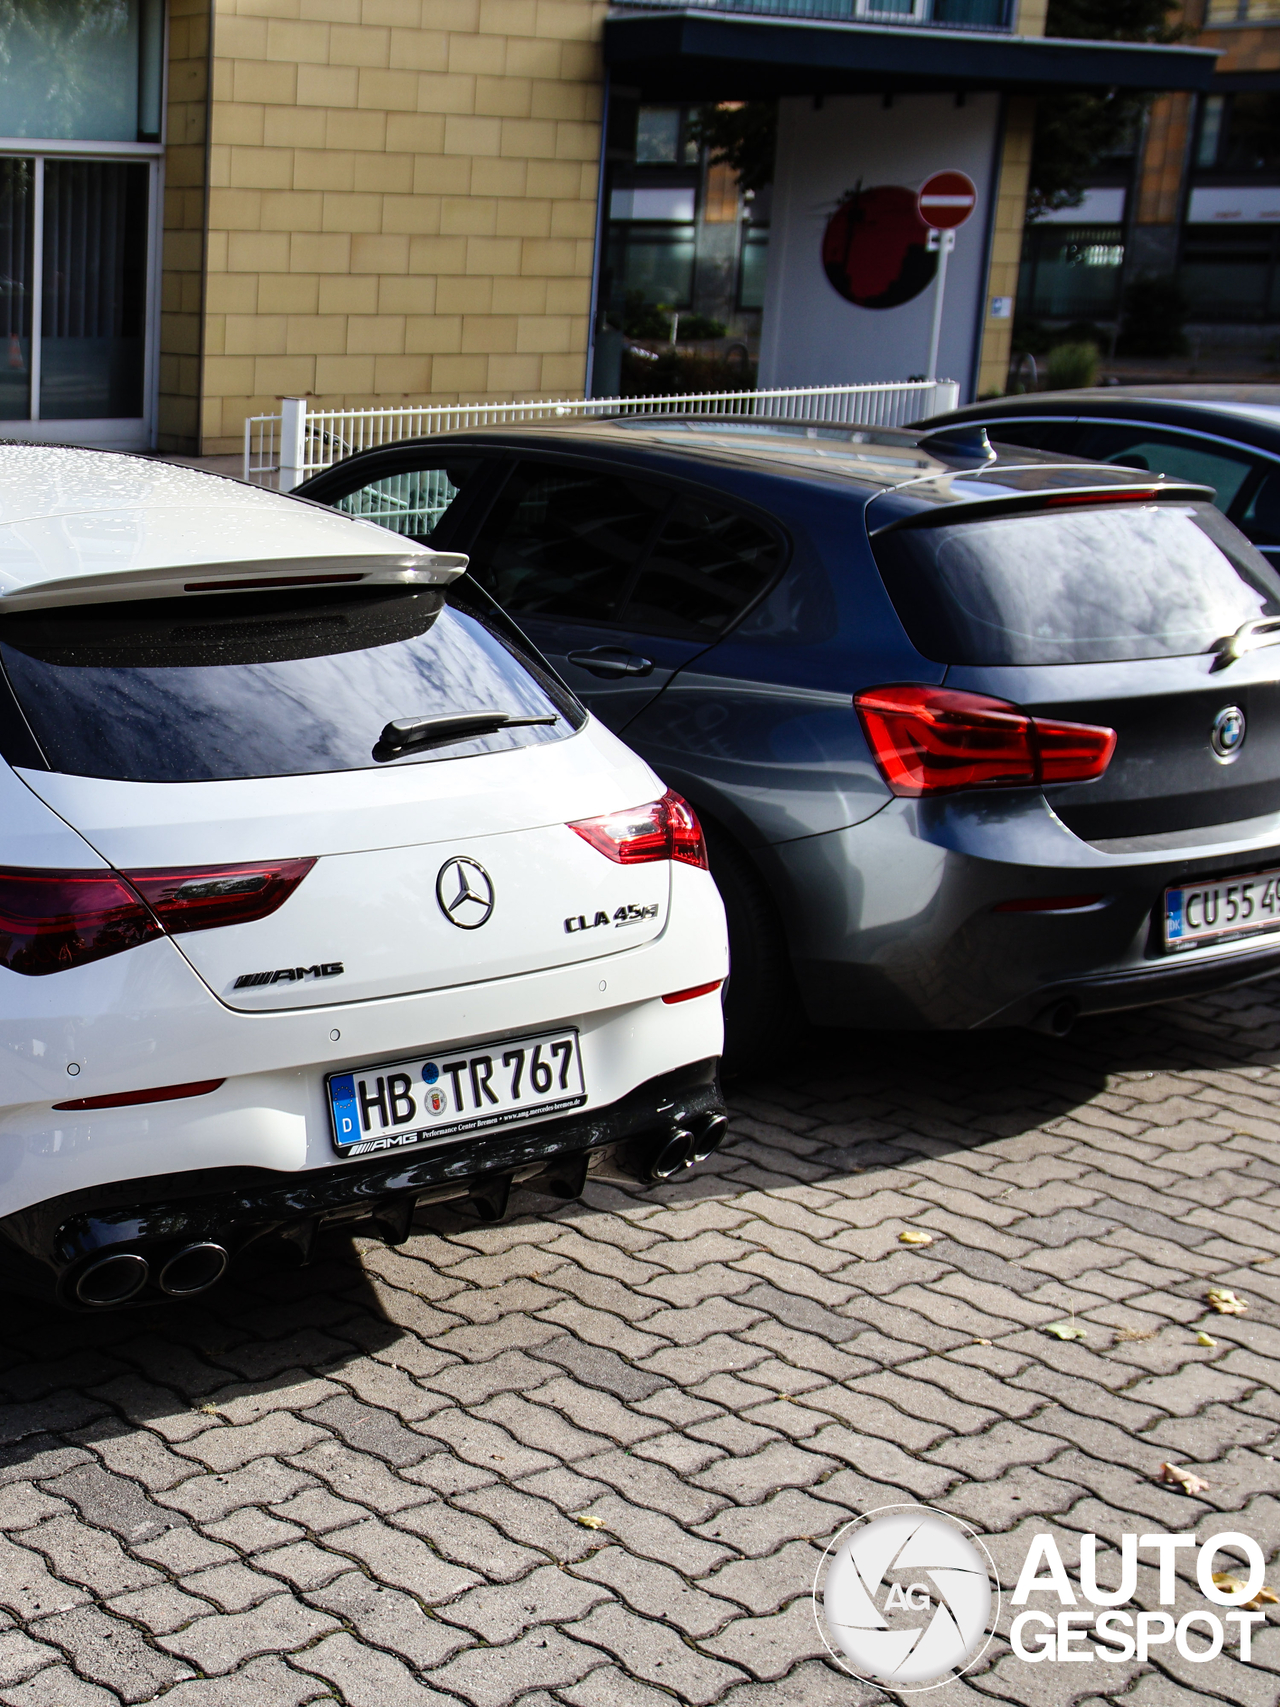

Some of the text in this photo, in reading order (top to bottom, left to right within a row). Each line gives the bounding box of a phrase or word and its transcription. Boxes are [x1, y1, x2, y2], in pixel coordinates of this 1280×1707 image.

[1186, 889, 1219, 928] CU
[1226, 882, 1255, 921] 55
[563, 911, 610, 933] CLA
[1169, 919, 1181, 931] DK
[358, 1072, 417, 1131] HB
[443, 1056, 499, 1112] TR
[503, 1040, 572, 1100] 767
[342, 1118, 352, 1133] D
[422, 1126, 458, 1139] Performance
[458, 1121, 477, 1131] Center
[477, 1117, 498, 1128] Bremen
[503, 1098, 581, 1121] www.amg.mercedes-bremen.de
